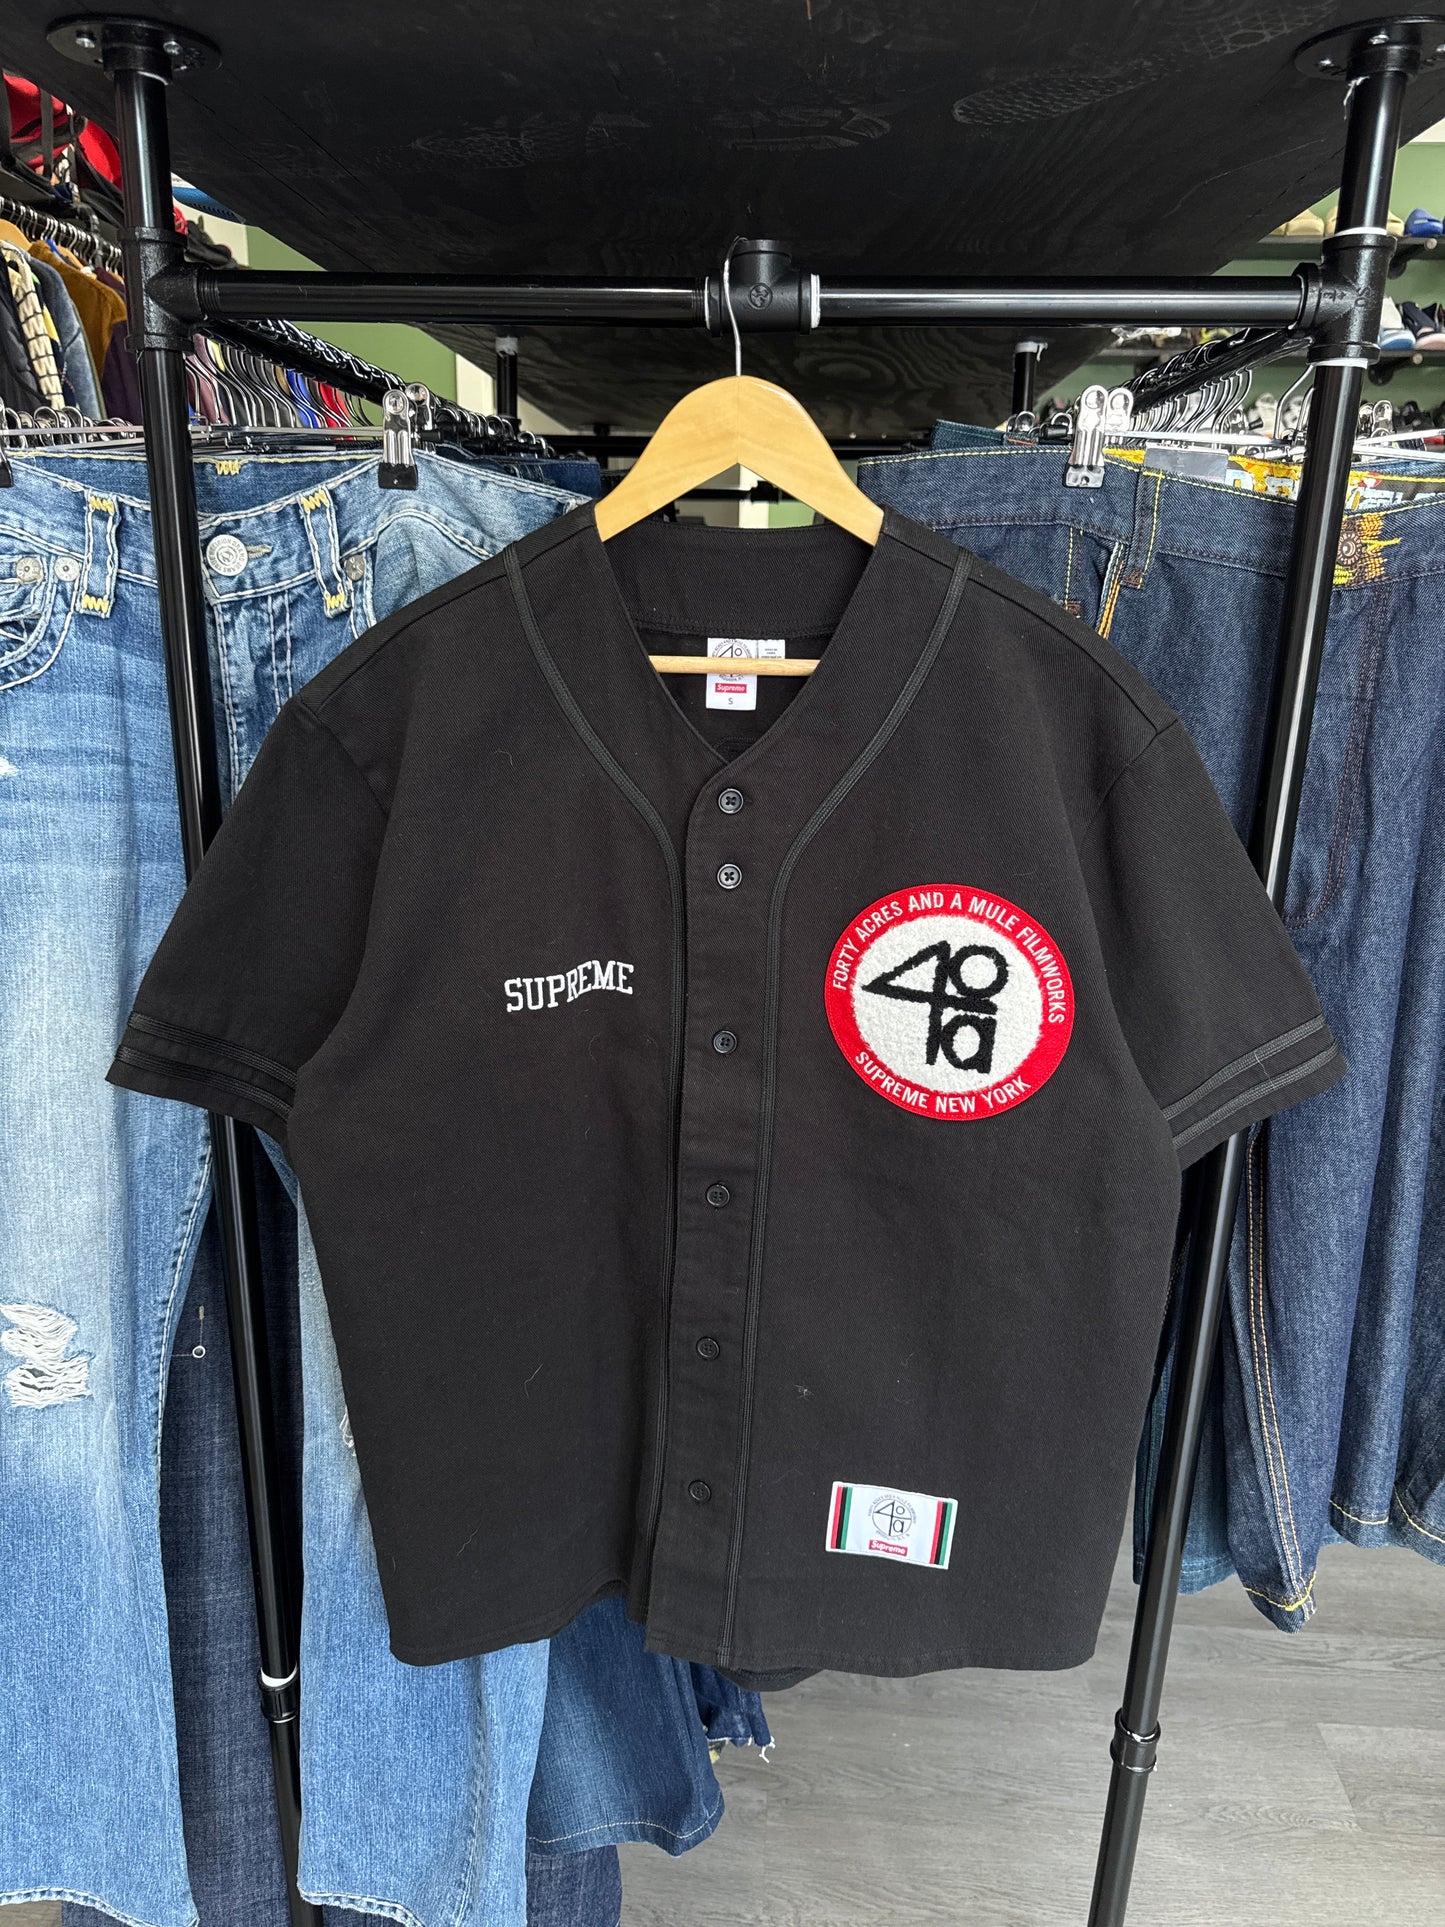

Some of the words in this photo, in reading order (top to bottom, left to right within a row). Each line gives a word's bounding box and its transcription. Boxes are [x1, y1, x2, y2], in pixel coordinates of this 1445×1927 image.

[717, 684, 745, 693] Supreme
[727, 697, 734, 705] S
[832, 941, 860, 991] FORTY
[854, 900, 904, 943] ACRES
[907, 890, 945, 913] AND
[950, 892, 962, 910] A
[967, 895, 1020, 932] MULE
[1015, 925, 1067, 1025] FILMWORKS
[503, 959, 635, 1013] SUPREME
[855, 1051, 929, 1109] SUPREME
[935, 1095, 976, 1114] NEW
[981, 1075, 1032, 1110] YORK
[871, 1540, 906, 1554] Supreme
